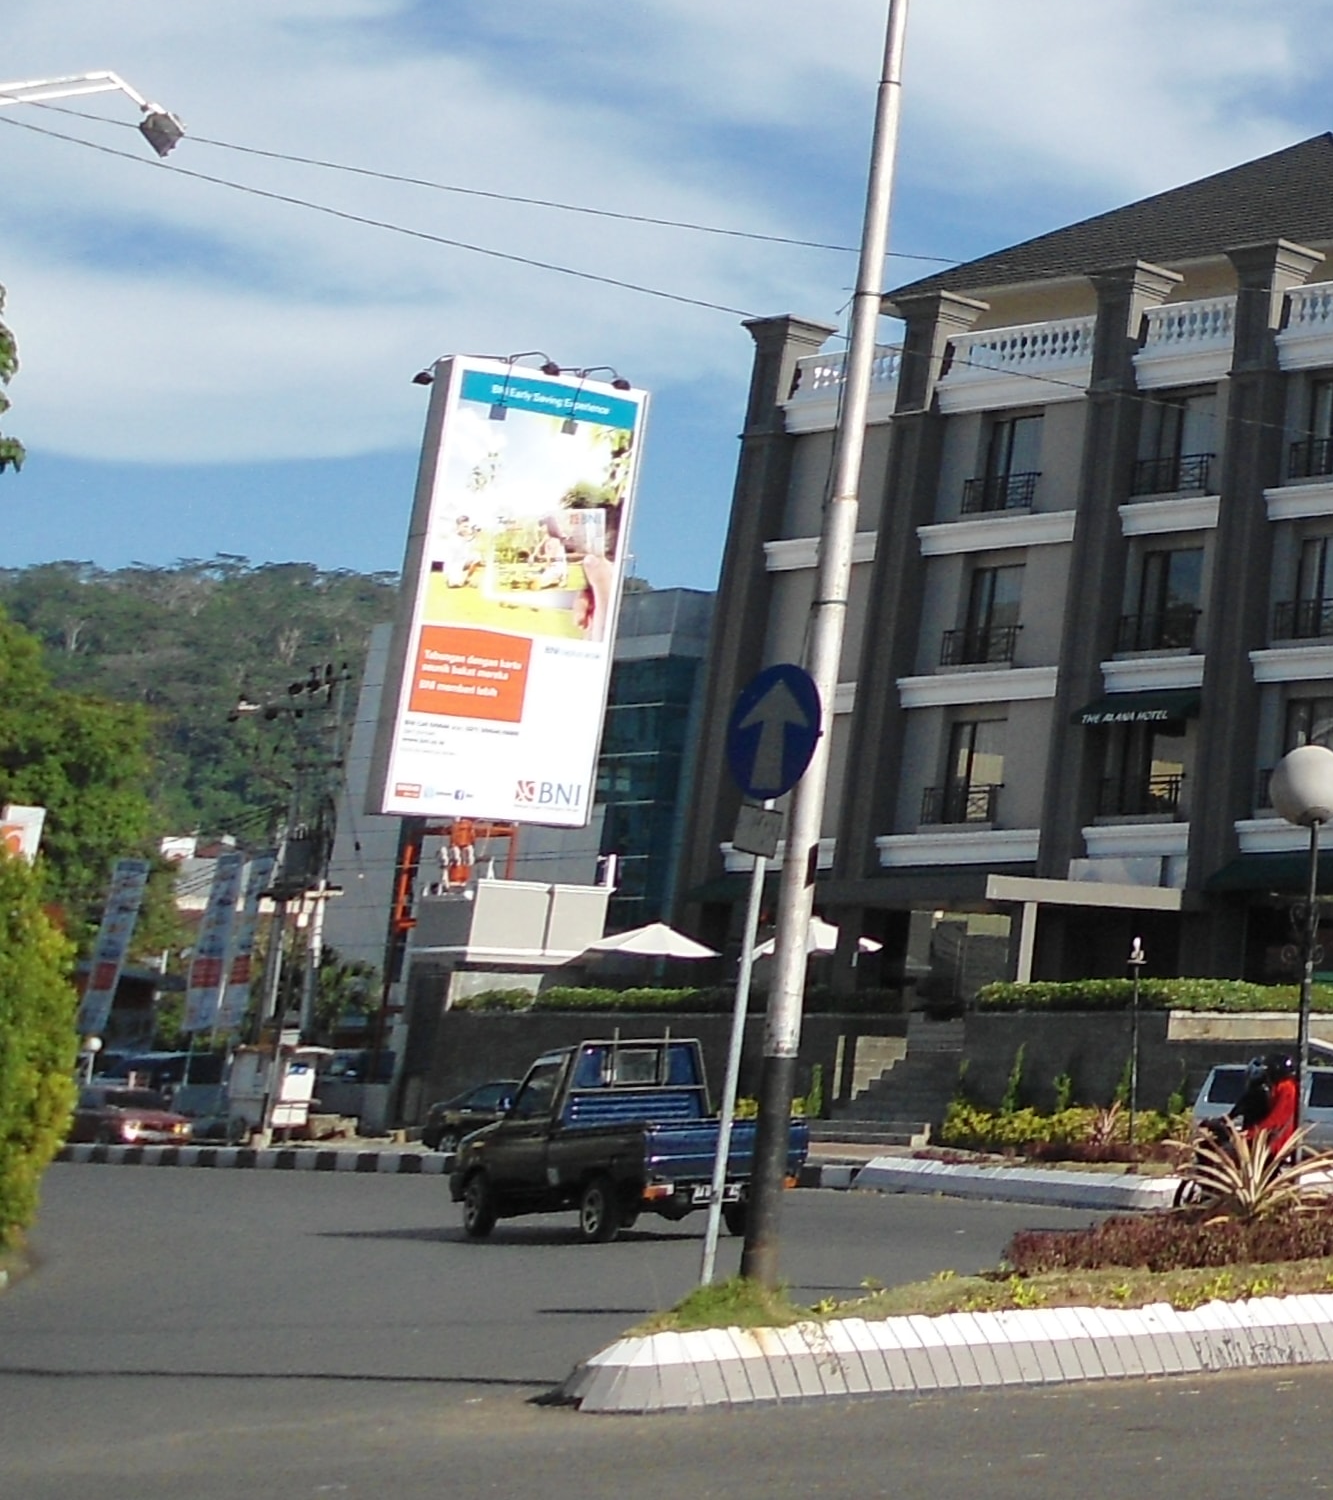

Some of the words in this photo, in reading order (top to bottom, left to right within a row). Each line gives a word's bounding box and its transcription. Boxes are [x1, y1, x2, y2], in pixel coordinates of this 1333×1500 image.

[1082, 714, 1100, 724] THE
[1137, 710, 1168, 720] HOTEL
[538, 781, 582, 807] BNI
